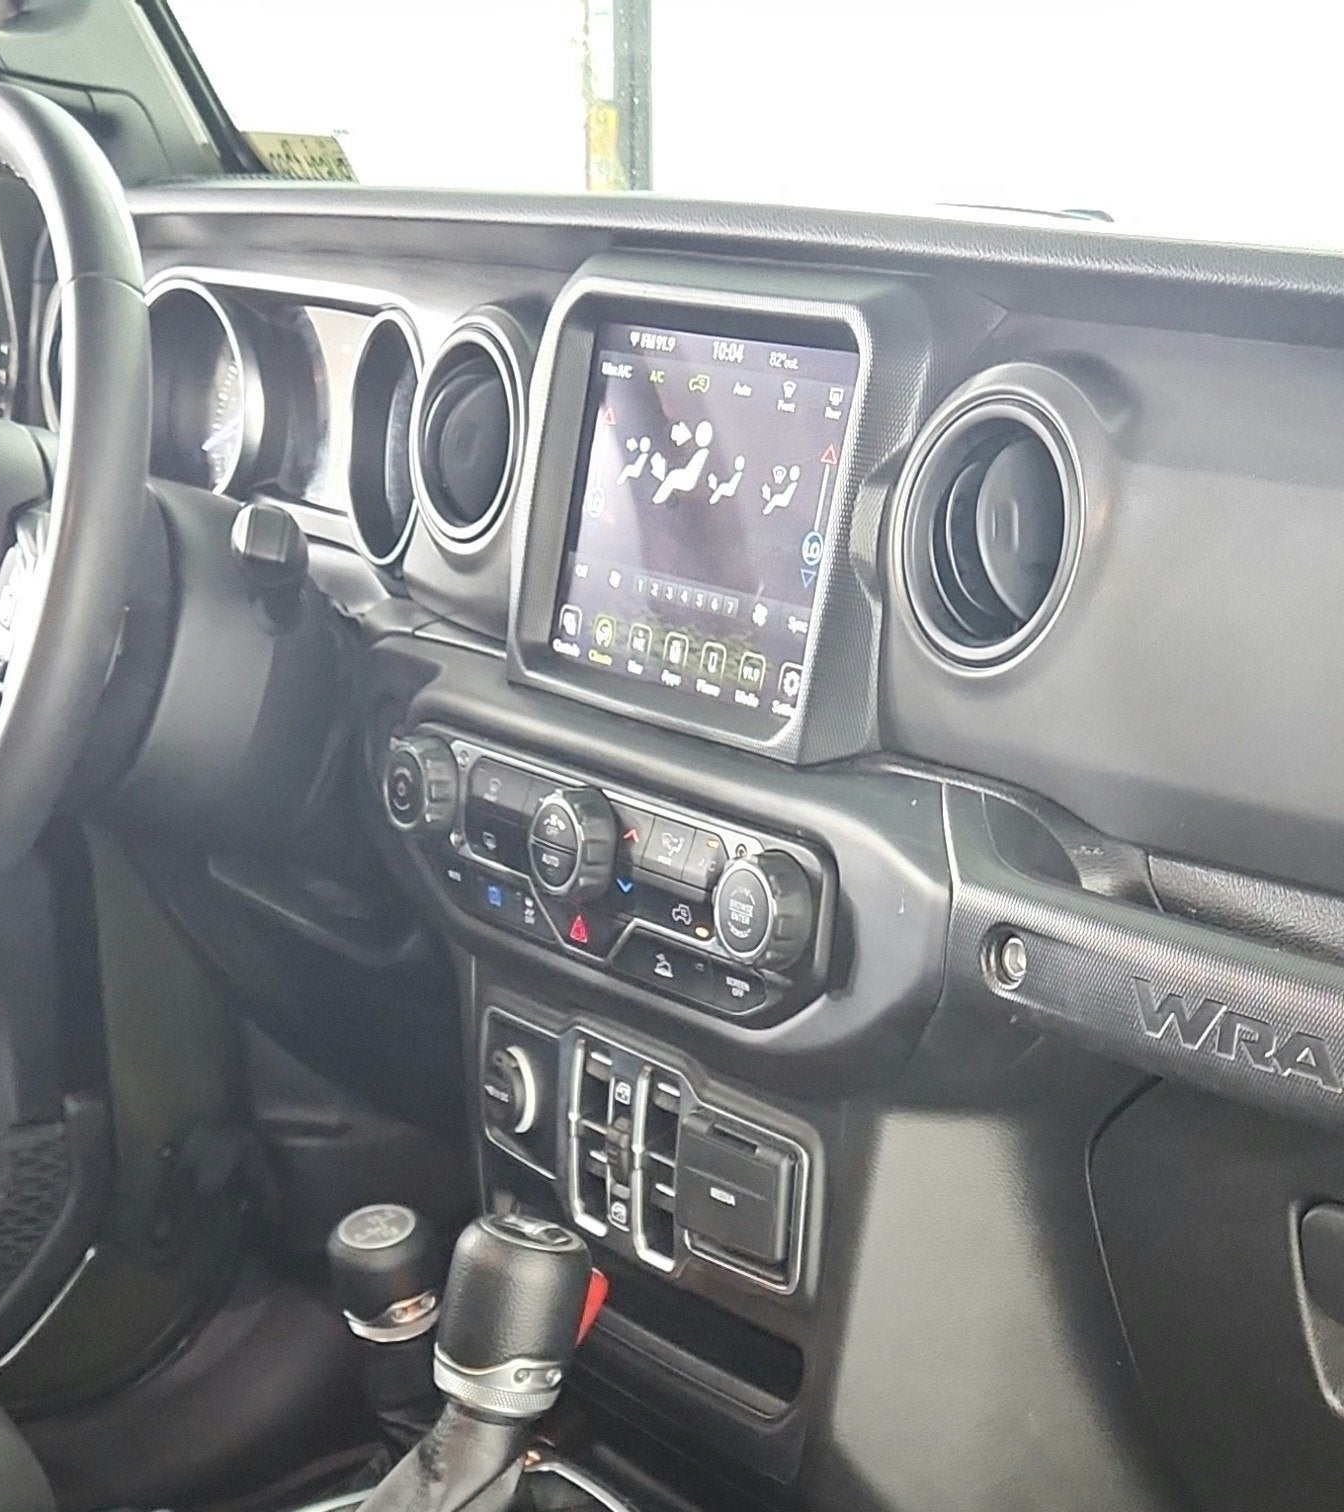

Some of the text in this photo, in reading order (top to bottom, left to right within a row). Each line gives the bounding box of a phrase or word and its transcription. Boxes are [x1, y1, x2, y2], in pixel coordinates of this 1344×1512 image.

[641, 333, 676, 352] FM 91.9
[712, 341, 744, 363] 10:04
[733, 383, 752, 397] Auto
[637, 578, 735, 615] 1 2 3 4 5 6 7
